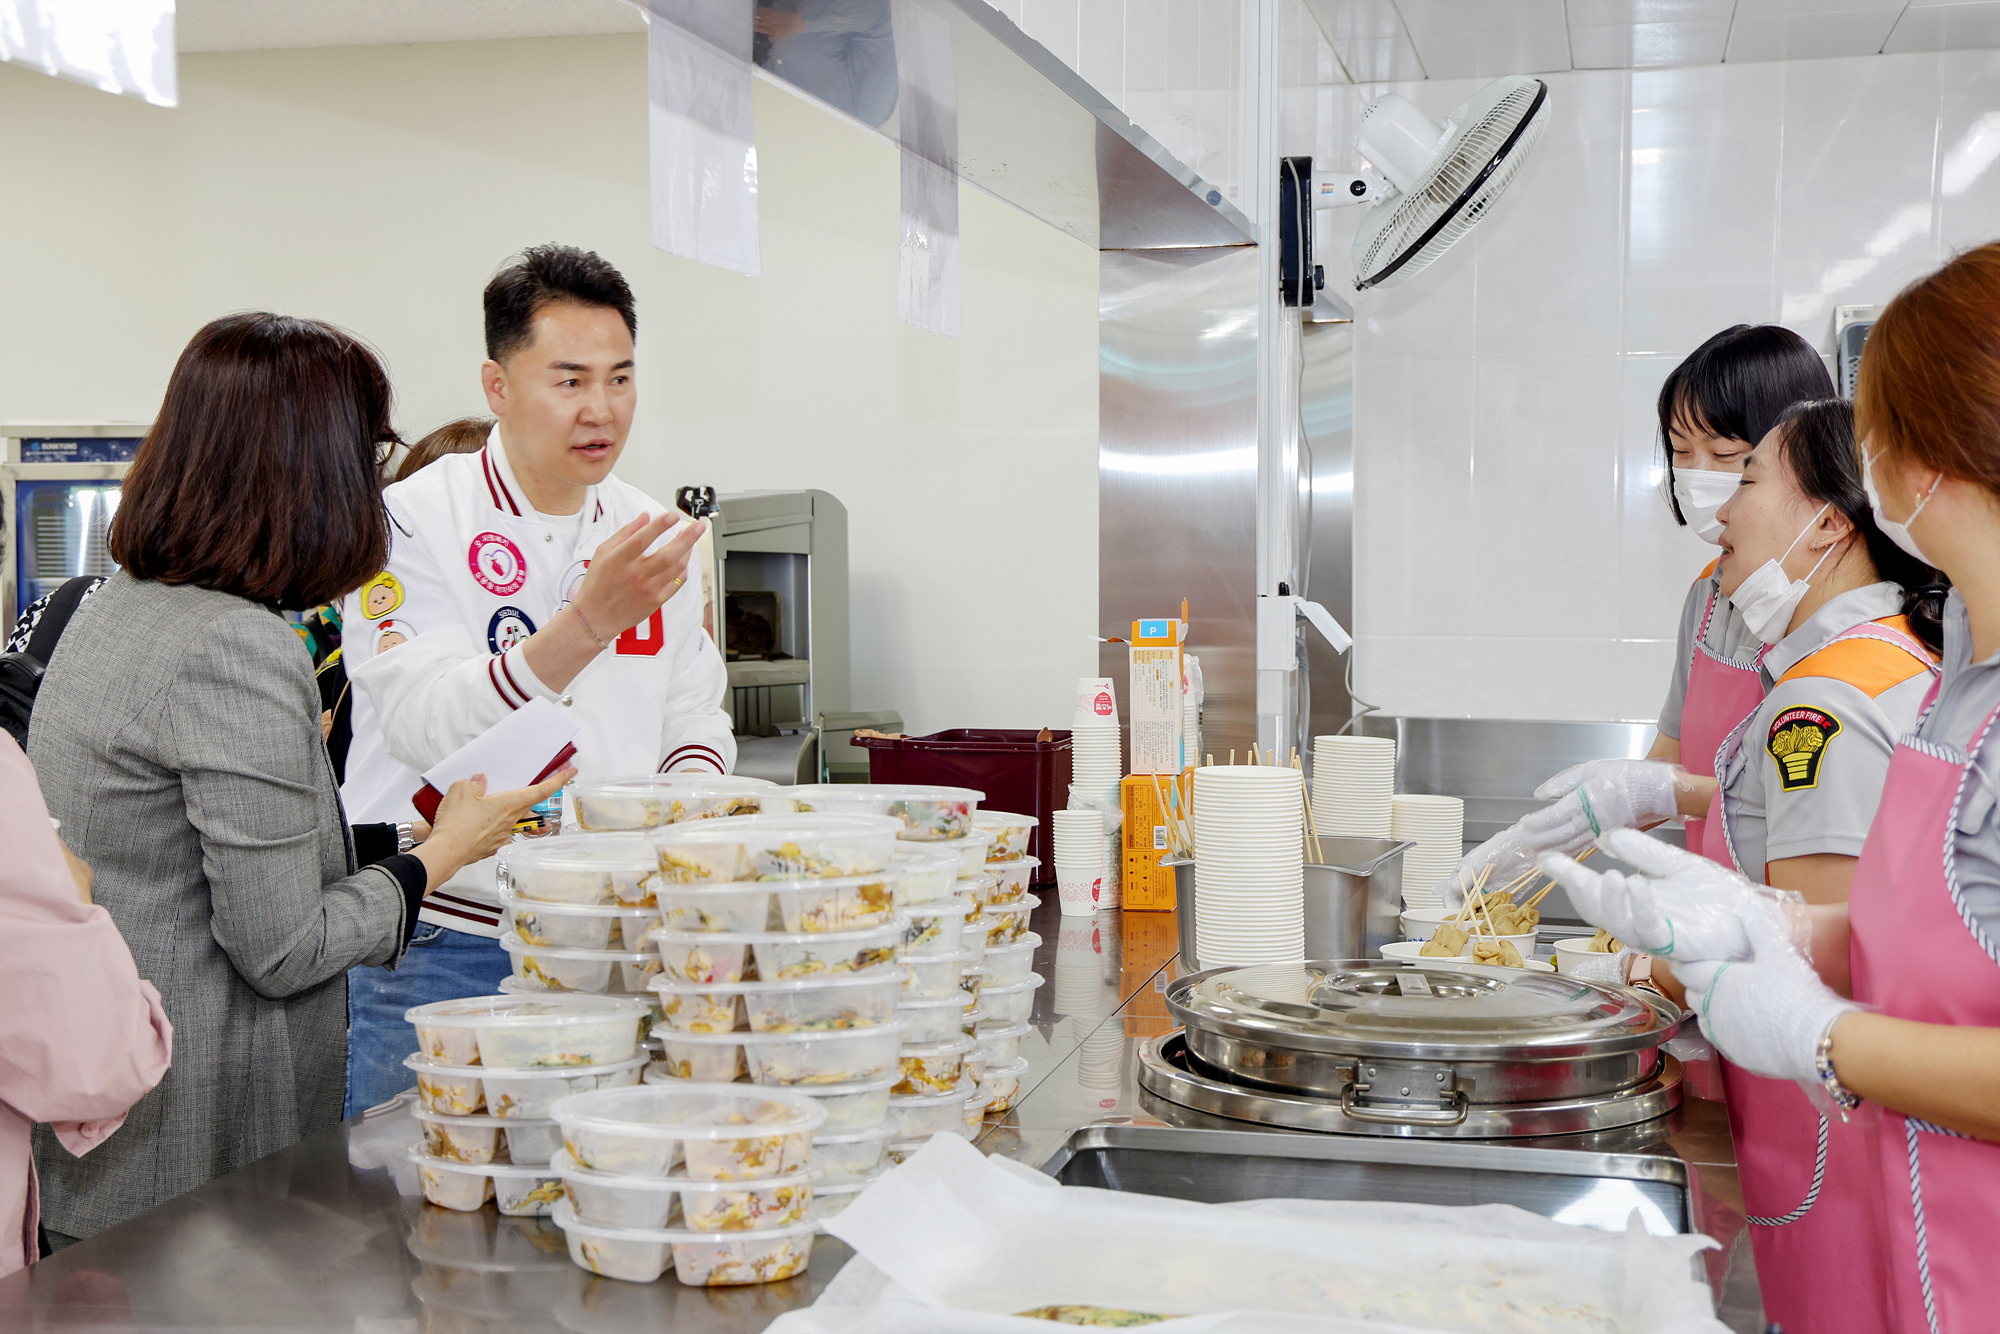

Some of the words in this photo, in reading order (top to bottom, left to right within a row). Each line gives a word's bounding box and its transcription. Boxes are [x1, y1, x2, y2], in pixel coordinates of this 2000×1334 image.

[1149, 626, 1157, 636] P
[1772, 711, 1805, 731] VOLUNTEER
[1805, 711, 1822, 723] FIRE
